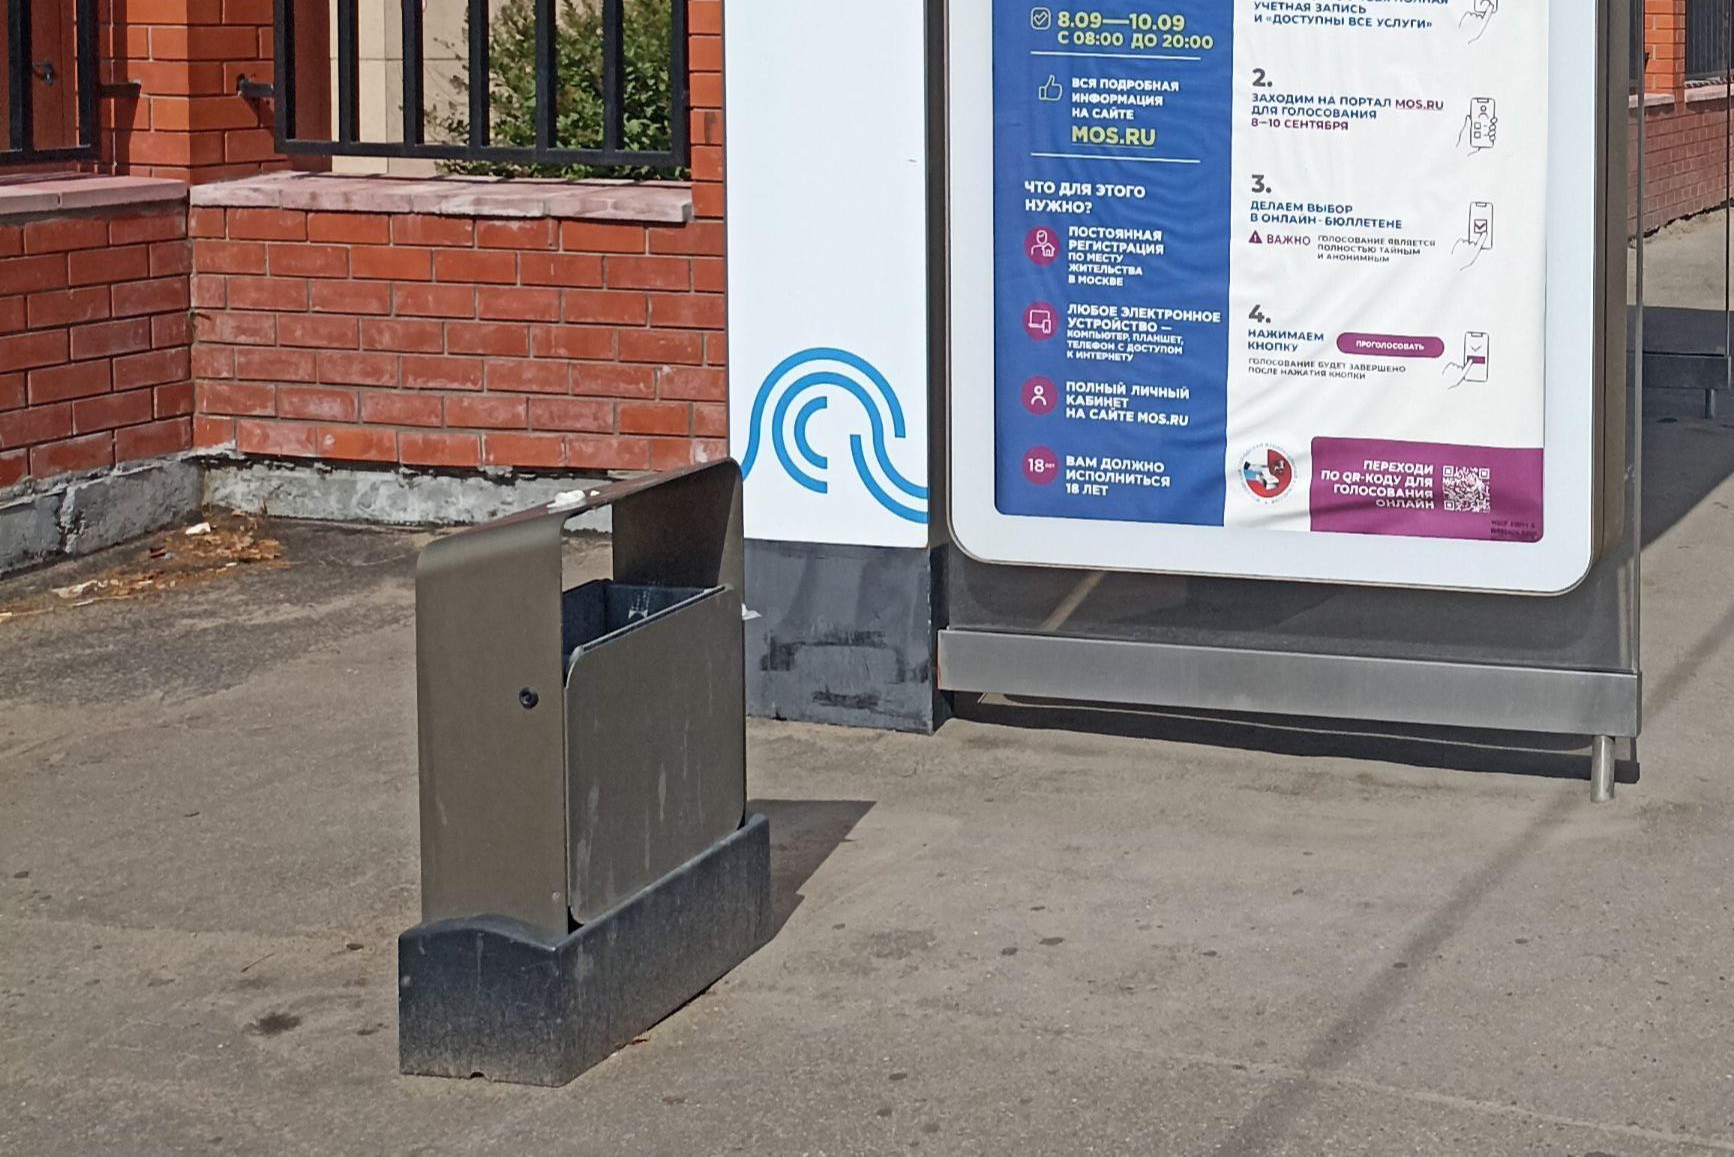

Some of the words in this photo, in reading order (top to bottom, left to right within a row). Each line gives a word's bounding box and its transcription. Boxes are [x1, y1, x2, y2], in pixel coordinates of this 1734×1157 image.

[1253, 1, 1311, 12] УЧЕТНАЯ
[1314, 3, 1367, 14] ЗАПИСЬ
[1254, 14, 1263, 24] И
[1348, 16, 1373, 27] ВСЕ
[1073, 31, 1124, 46] 08:00
[1130, 33, 1157, 49] ДО
[1162, 35, 1214, 50] 20:00
[1071, 77, 1097, 89] ВСЯ
[1100, 79, 1180, 92] ПОДРОБНАЯ
[1071, 93, 1163, 107] ИНФОРМАЦИЯ
[1251, 92, 1314, 105] ЗАХОДИМ
[1318, 95, 1336, 105] НА
[1339, 96, 1392, 108] ПОРТАЛ
[1395, 99, 1444, 110] MOS.RU
[1071, 108, 1089, 118] НА
[1092, 107, 1134, 120] САЙТЕ
[1251, 106, 1278, 117] ДЛЯ
[1281, 107, 1378, 120] ГОЛОСОВАНИЯ
[1283, 119, 1349, 130] СЕНТЯБРЯ
[1071, 126, 1157, 146] MOS.RU
[1024, 180, 1056, 194] ЧТО
[1059, 182, 1092, 197] ДЛЯ
[1096, 184, 1146, 198] ЭТОГО
[1025, 198, 1093, 214] НУЖНО?
[1250, 200, 1304, 213] ДЕЛАЕМ
[1306, 203, 1354, 215] ВЫБОР
[1250, 213, 1259, 223] В
[1068, 226, 1162, 242] ПОСТОЯННАЯ
[1267, 233, 1311, 247] ВАЖНО
[1317, 235, 1386, 245] ГОЛОСОВАНИЕ
[1068, 240, 1164, 256] РЕГИСТРАЦИЯ
[1317, 244, 1377, 254] ПОЛНОСТЬЮ
[1380, 245, 1421, 256] ТАЙНЫМ
[1068, 252, 1084, 261] ПО
[1087, 254, 1123, 263] МЕСТУ
[1068, 264, 1143, 276] ЖИТЕЛЬСТВА
[1068, 275, 1076, 284] В
[1077, 276, 1124, 286] МОСКВЕ
[1067, 303, 1118, 317] ЛЮБОЕ
[1120, 306, 1221, 323] ЭЛЕКТРОННОЕ
[1067, 316, 1158, 332] УСТРОЙСТВО
[1066, 329, 1131, 342] КОМПЬЮТЕР,
[1132, 333, 1184, 345] ПЛАНШЕТ,
[1248, 328, 1324, 341] НАЖИМАЕМ
[1067, 339, 1115, 351] ТЕЛЕФОН
[1126, 343, 1183, 355] ДОСТУПОМ
[1248, 341, 1299, 353] КНОПКУ
[1355, 339, 1425, 351] ПРОГОЛОСОВАТЬ
[1075, 351, 1134, 363] ИНТЕРНЕТУ
[1066, 381, 1126, 395] ПОЛНЫЙ
[1131, 385, 1190, 400] ЛИЧНЫЙ
[1066, 394, 1129, 408] КАБИНЕТ
[1066, 408, 1086, 419] НА
[1089, 407, 1134, 422] САЙТЕ
[1137, 413, 1189, 427] MOS.RU
[1028, 458, 1044, 472] 18
[1066, 455, 1097, 468] ВАМ
[1100, 457, 1165, 473] ДОЛЖНО
[1363, 459, 1434, 475] ПЕРЕХОДИ
[1066, 469, 1171, 487] ИСПОЛНИТЬСЯ
[1321, 470, 1340, 481] ПО
[1342, 472, 1401, 486] QR-КОДУ
[1404, 475, 1433, 488] ДЛЯ
[1065, 483, 1079, 494] 18
[1082, 484, 1109, 497] ЛЕТ
[1333, 483, 1434, 499] ГОЛОСОВАНИЯ
[1375, 496, 1435, 510] ОНЛАЙН
